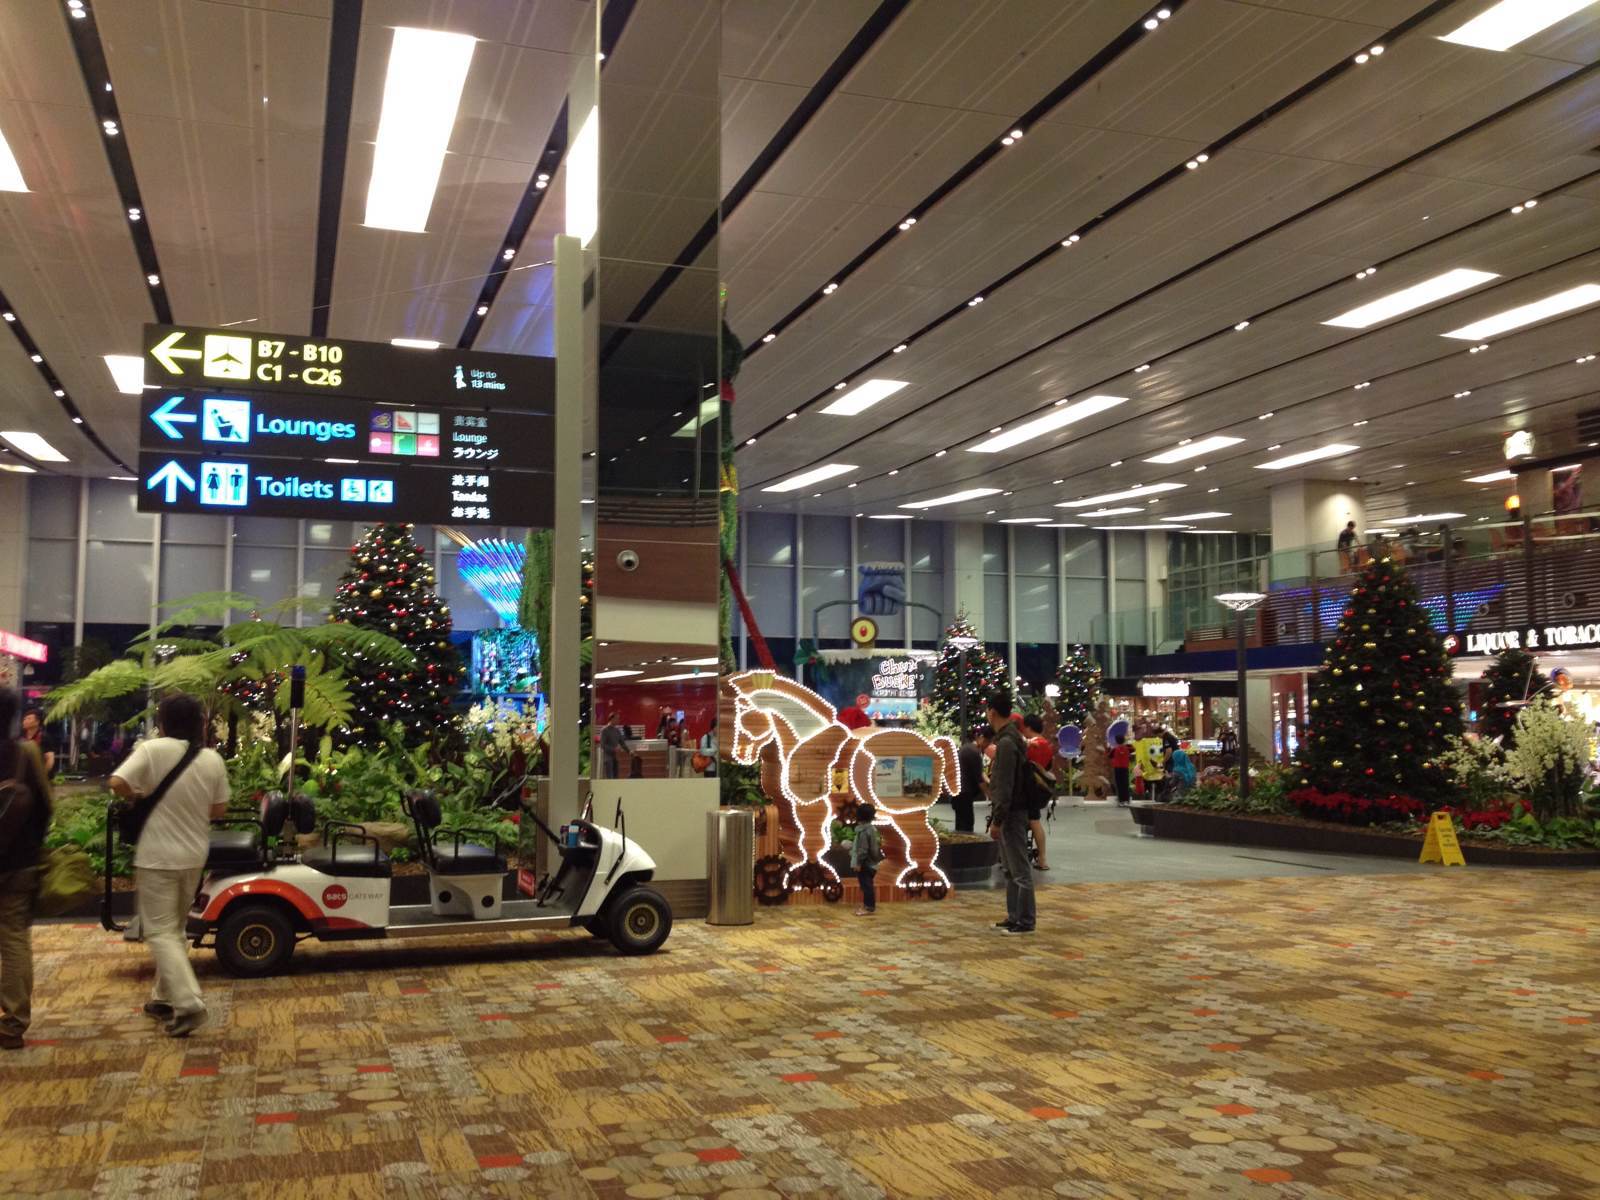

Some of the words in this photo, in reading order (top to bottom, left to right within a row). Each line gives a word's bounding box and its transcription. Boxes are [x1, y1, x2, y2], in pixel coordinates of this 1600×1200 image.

[258, 340, 285, 358] B7
[304, 344, 342, 363] B10
[257, 363, 282, 381] C1
[303, 367, 341, 386] C26
[471, 369, 485, 379] Up
[485, 371, 497, 379] to
[483, 381, 505, 390] mins
[255, 413, 355, 441] Lounges
[453, 432, 487, 445] Lounge
[453, 447, 498, 459] ラウンジ
[255, 476, 333, 498] Toilets
[1467, 631, 1520, 655] LIQUOR
[1527, 629, 1538, 647] &
